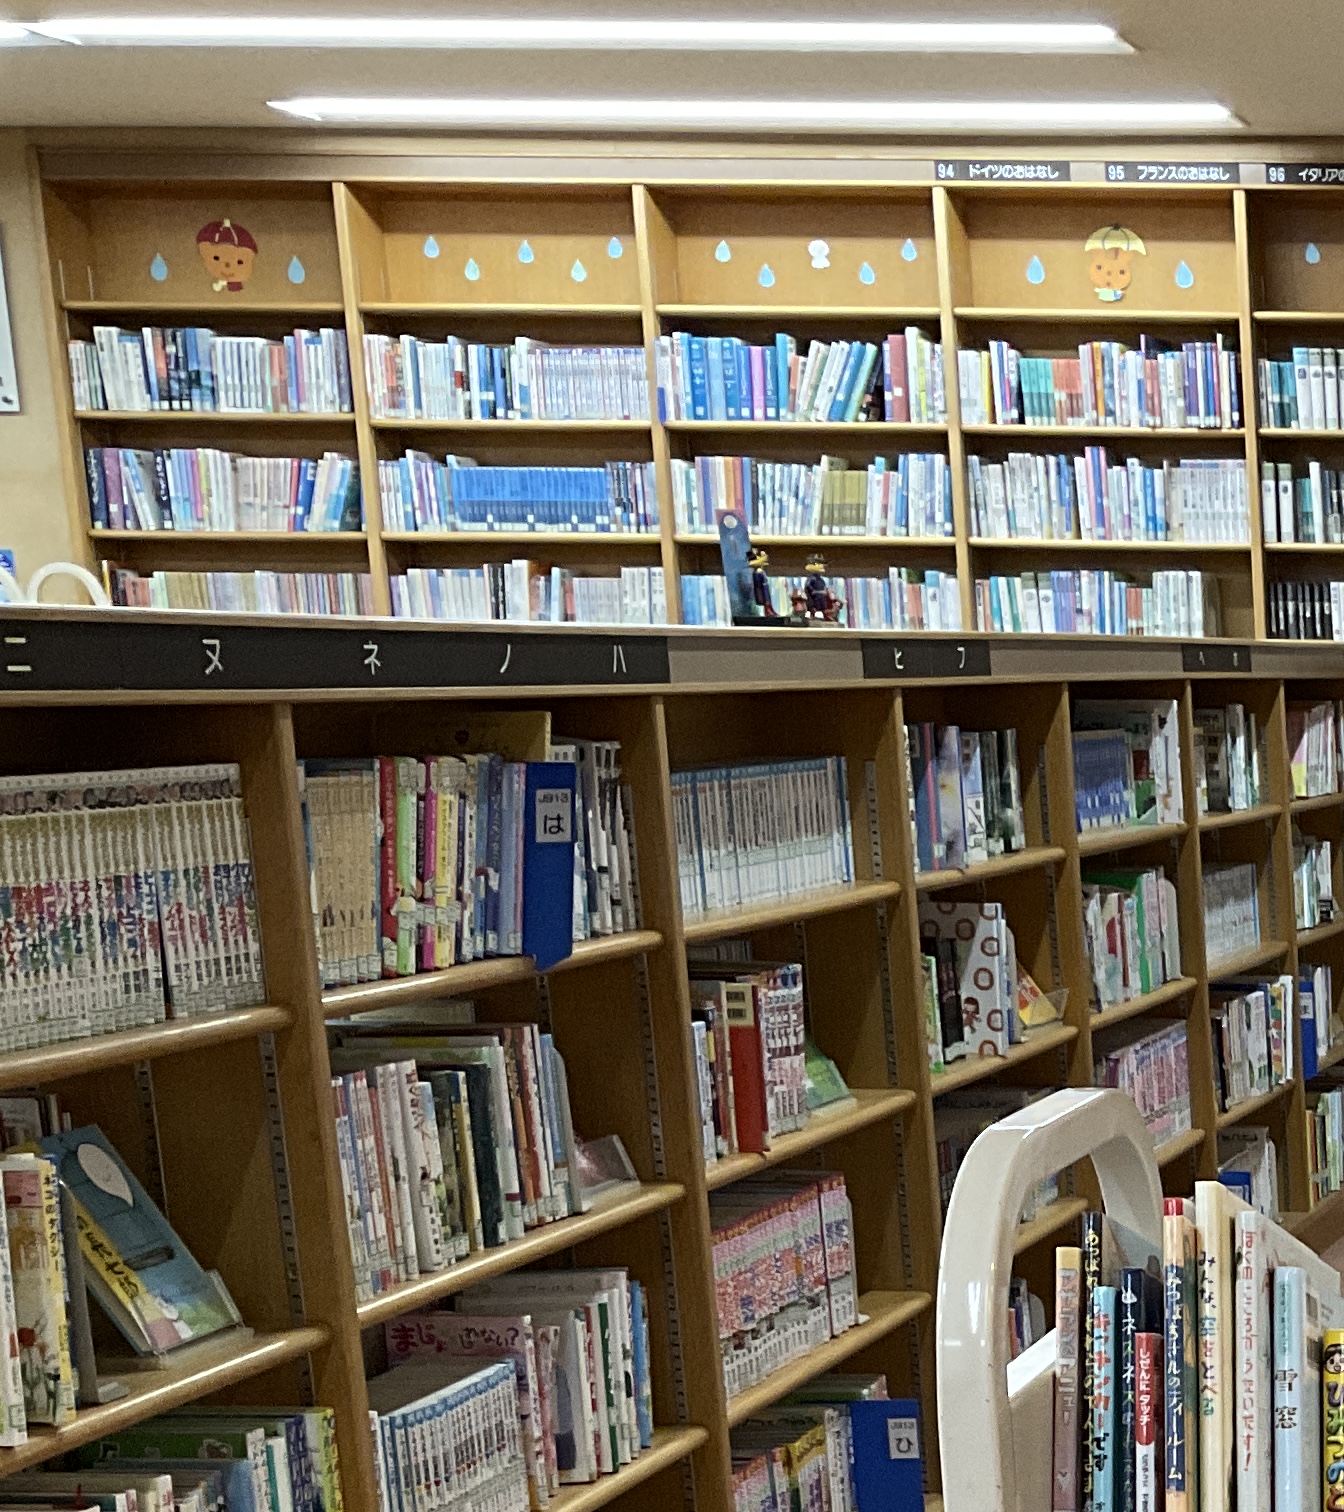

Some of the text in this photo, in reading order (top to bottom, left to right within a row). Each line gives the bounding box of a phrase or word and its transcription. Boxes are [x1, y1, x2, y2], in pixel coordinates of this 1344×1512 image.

[938, 164, 1059, 178] 94 ドイツのおはなし
[1108, 166, 1230, 180] 95 フランスのおはなし
[1269, 168, 1285, 182] 96
[202, 638, 224, 675] ヌ
[362, 640, 382, 676] ネ
[542, 811, 566, 836] は
[1273, 1369, 1298, 1429] 雪窓
[894, 1436, 914, 1454] ひ
